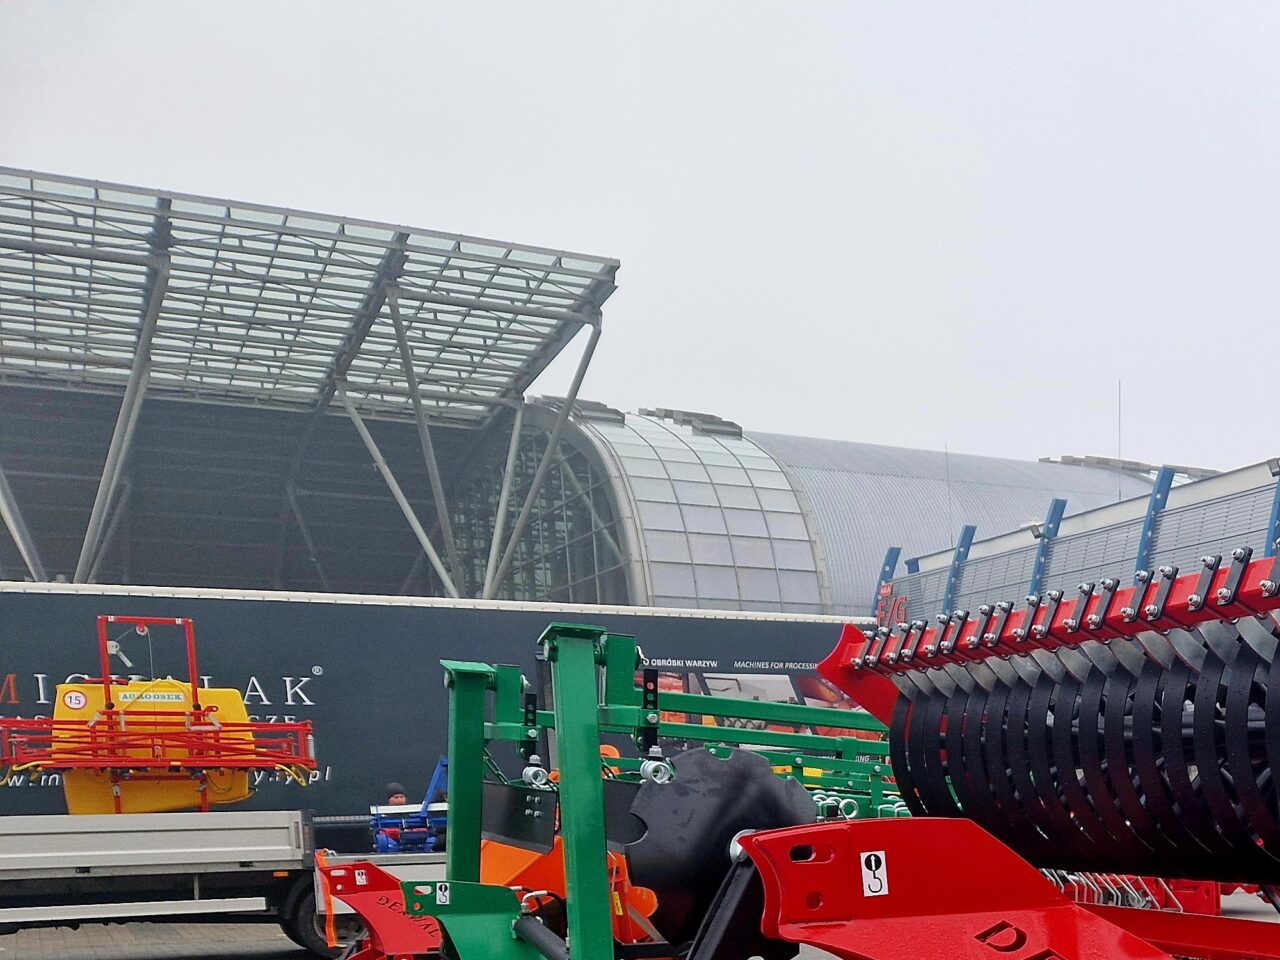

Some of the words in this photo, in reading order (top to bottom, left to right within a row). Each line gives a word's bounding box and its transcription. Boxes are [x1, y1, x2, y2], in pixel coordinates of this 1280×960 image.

[650, 658, 684, 668] OBRÓBKI
[684, 660, 719, 669] WARZYW
[733, 659, 769, 669] MACHINES
[770, 661, 784, 669] FOR
[67, 694, 82, 706] 15
